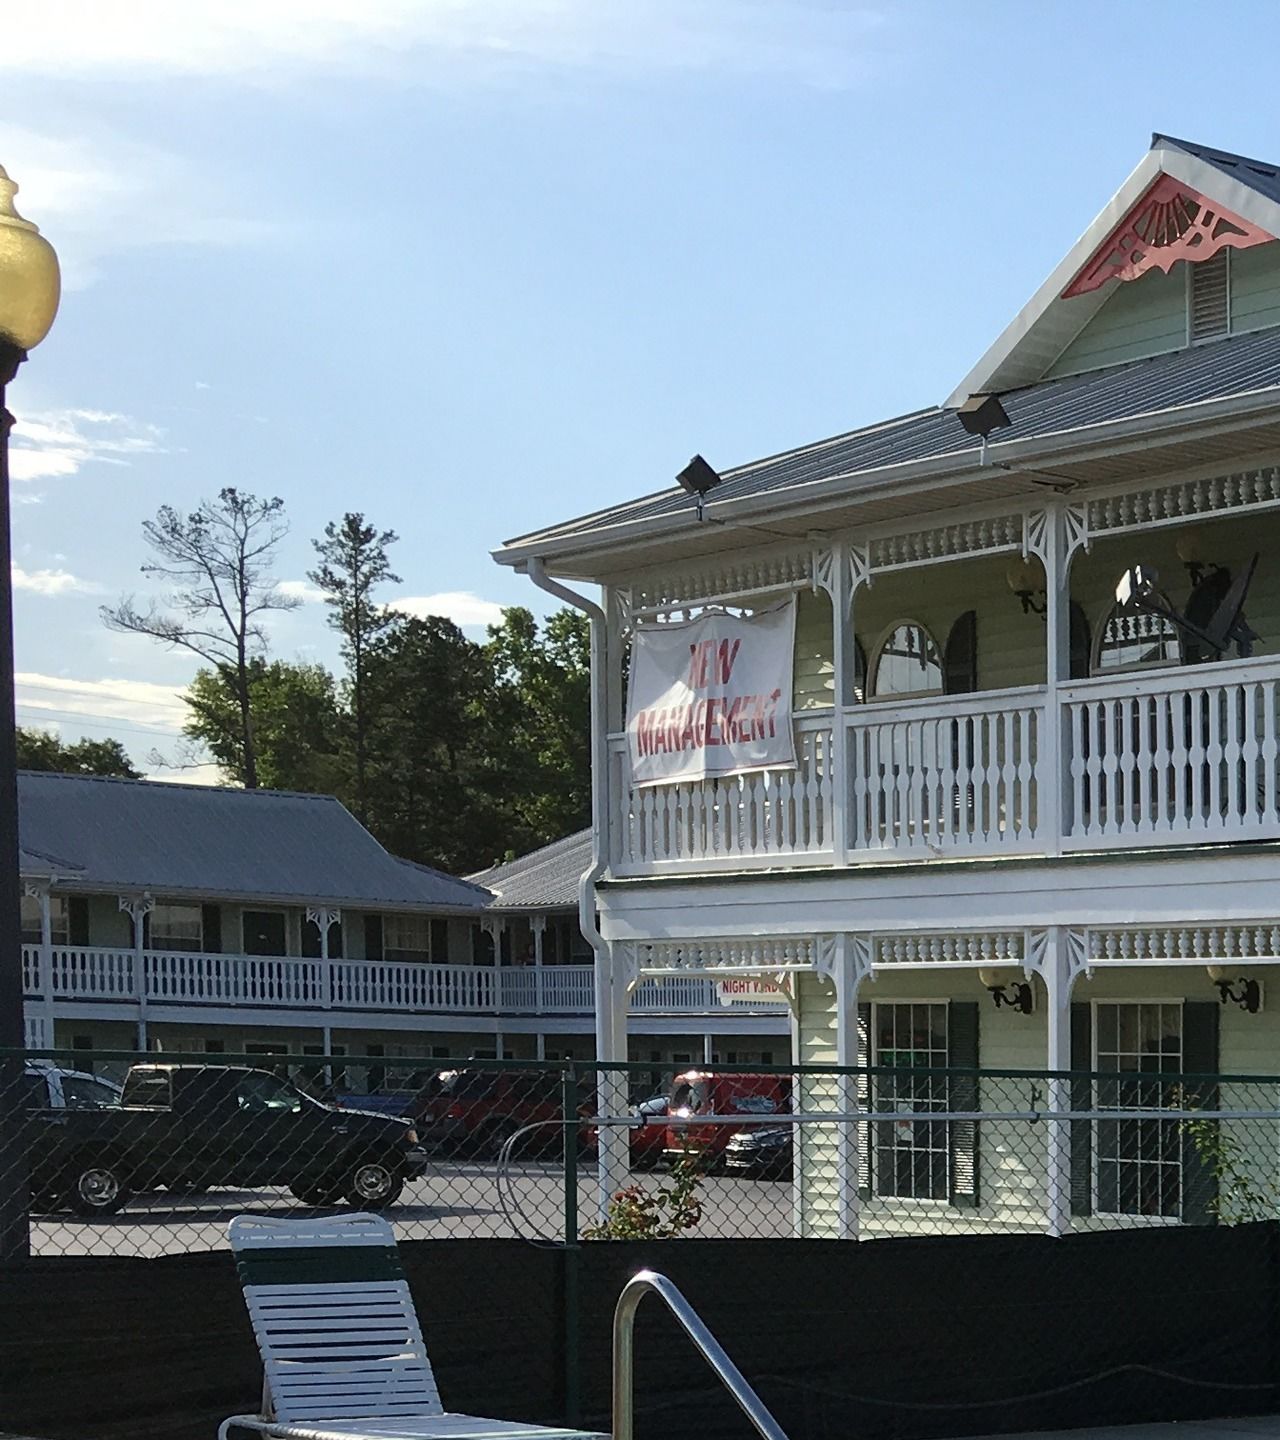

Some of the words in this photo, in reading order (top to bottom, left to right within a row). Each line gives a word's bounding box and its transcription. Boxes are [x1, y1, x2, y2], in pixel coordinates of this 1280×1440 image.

[688, 638, 742, 689] NEW
[637, 688, 781, 758] MANAGEMENT
[722, 980, 750, 993] NIGHT
